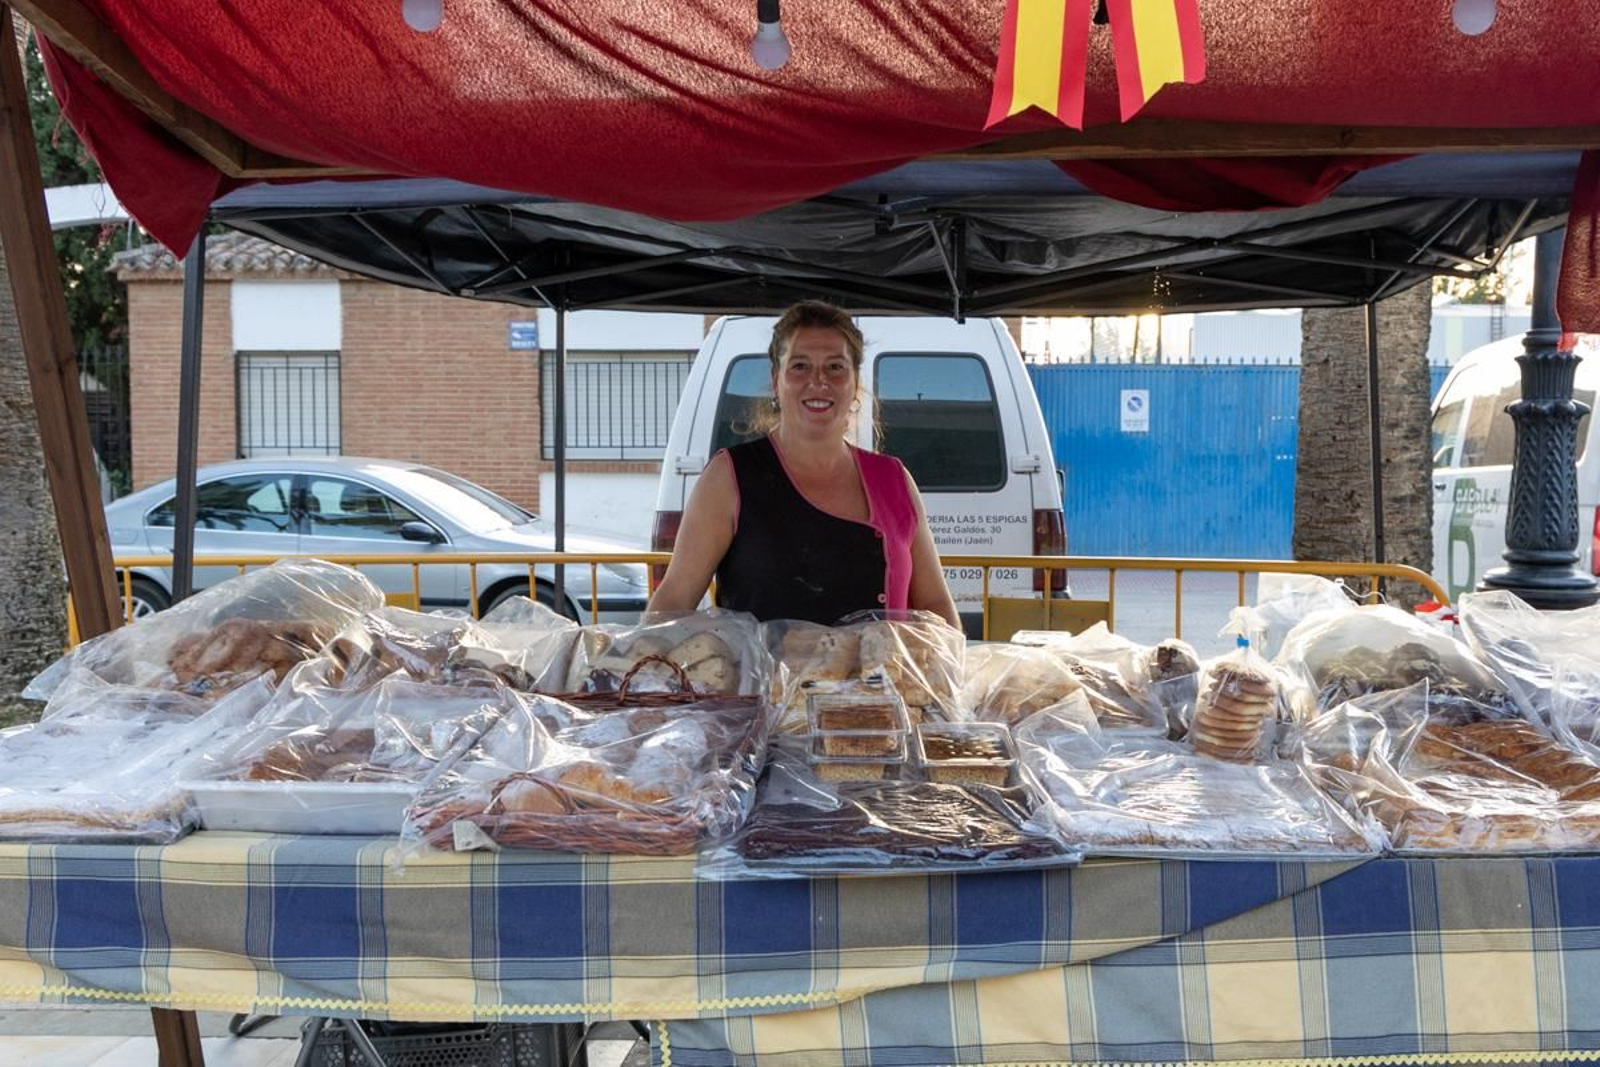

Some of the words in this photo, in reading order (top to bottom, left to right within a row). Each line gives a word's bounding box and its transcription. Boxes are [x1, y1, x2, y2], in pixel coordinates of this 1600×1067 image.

[926, 515, 955, 524] DERIA
[956, 515, 975, 524] LAS
[977, 515, 984, 524] 5
[985, 515, 1028, 524] ESPIGAS
[989, 525, 1002, 534] 30
[942, 568, 957, 580] 75
[960, 568, 982, 580] 029
[995, 568, 1018, 580] 026
